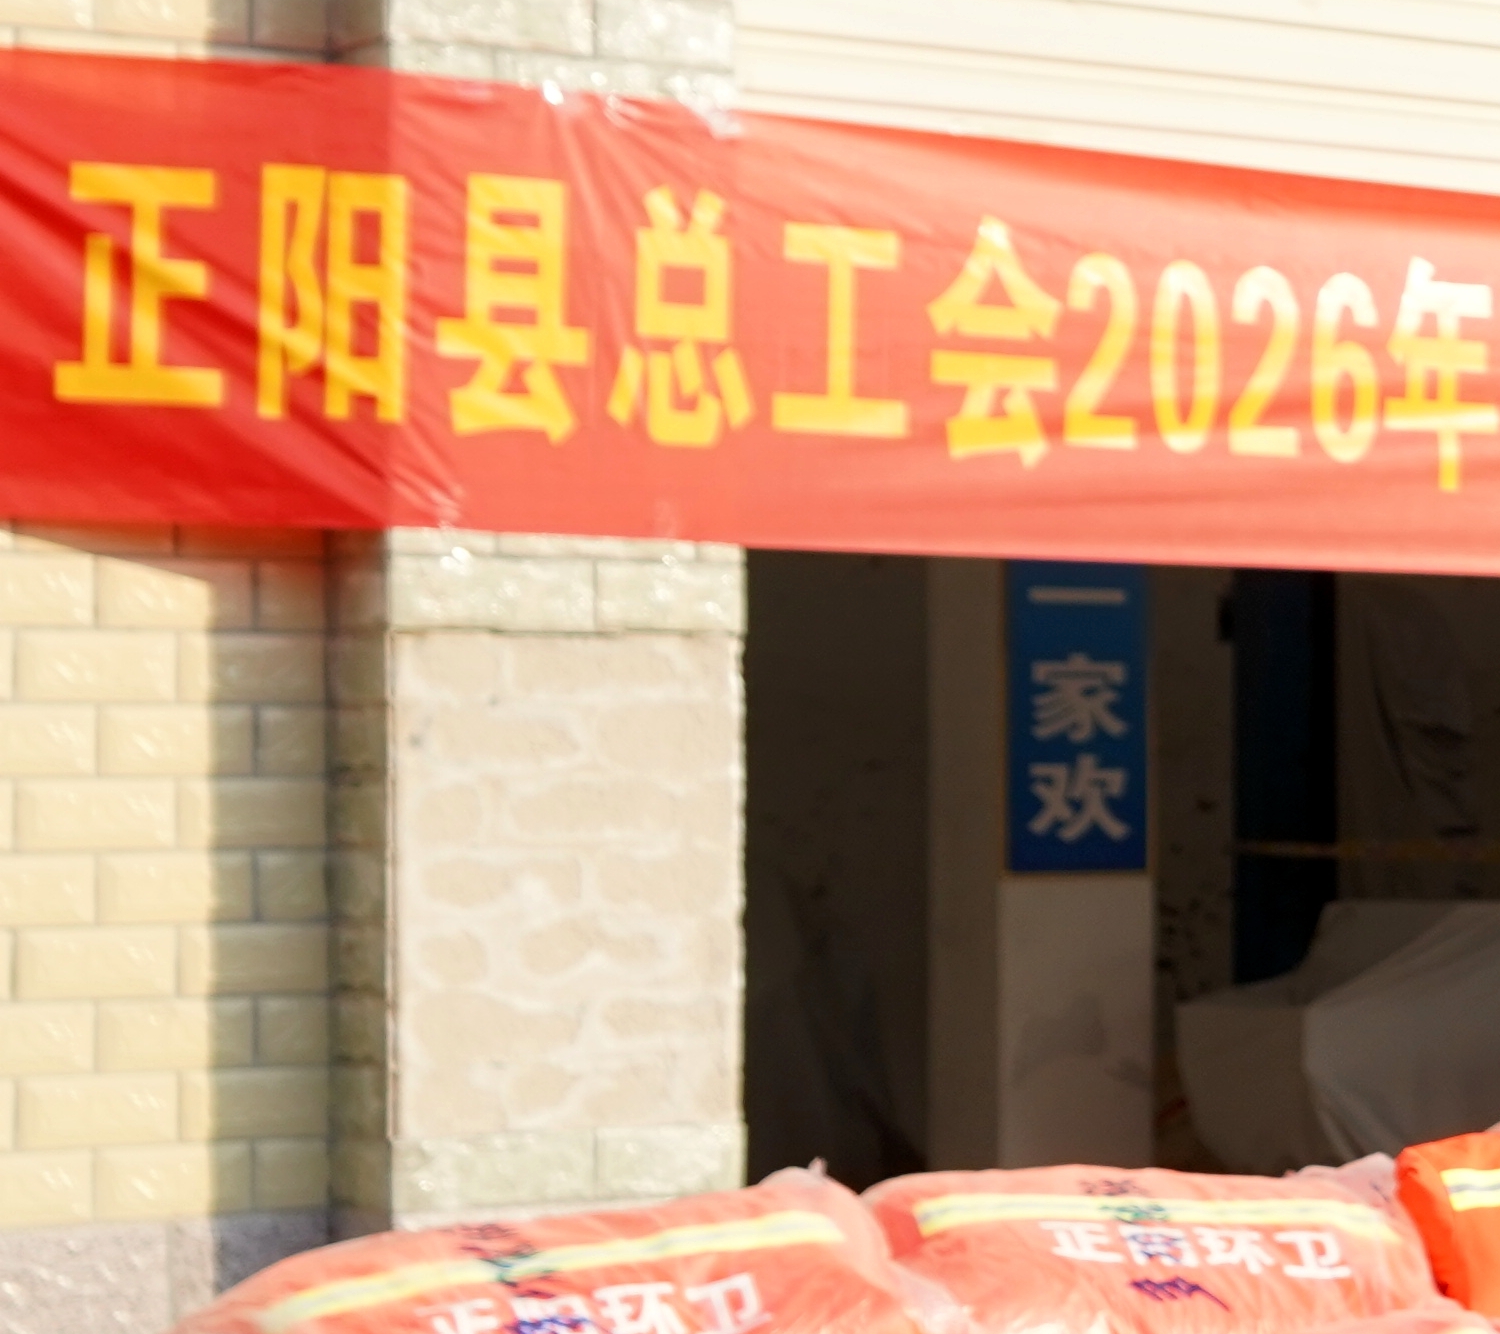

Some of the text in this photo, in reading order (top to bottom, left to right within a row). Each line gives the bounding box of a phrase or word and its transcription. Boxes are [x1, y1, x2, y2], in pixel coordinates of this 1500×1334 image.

[1028, 584, 1131, 843] 一家欢
[1038, 1219, 1352, 1280] 正阳环卫
